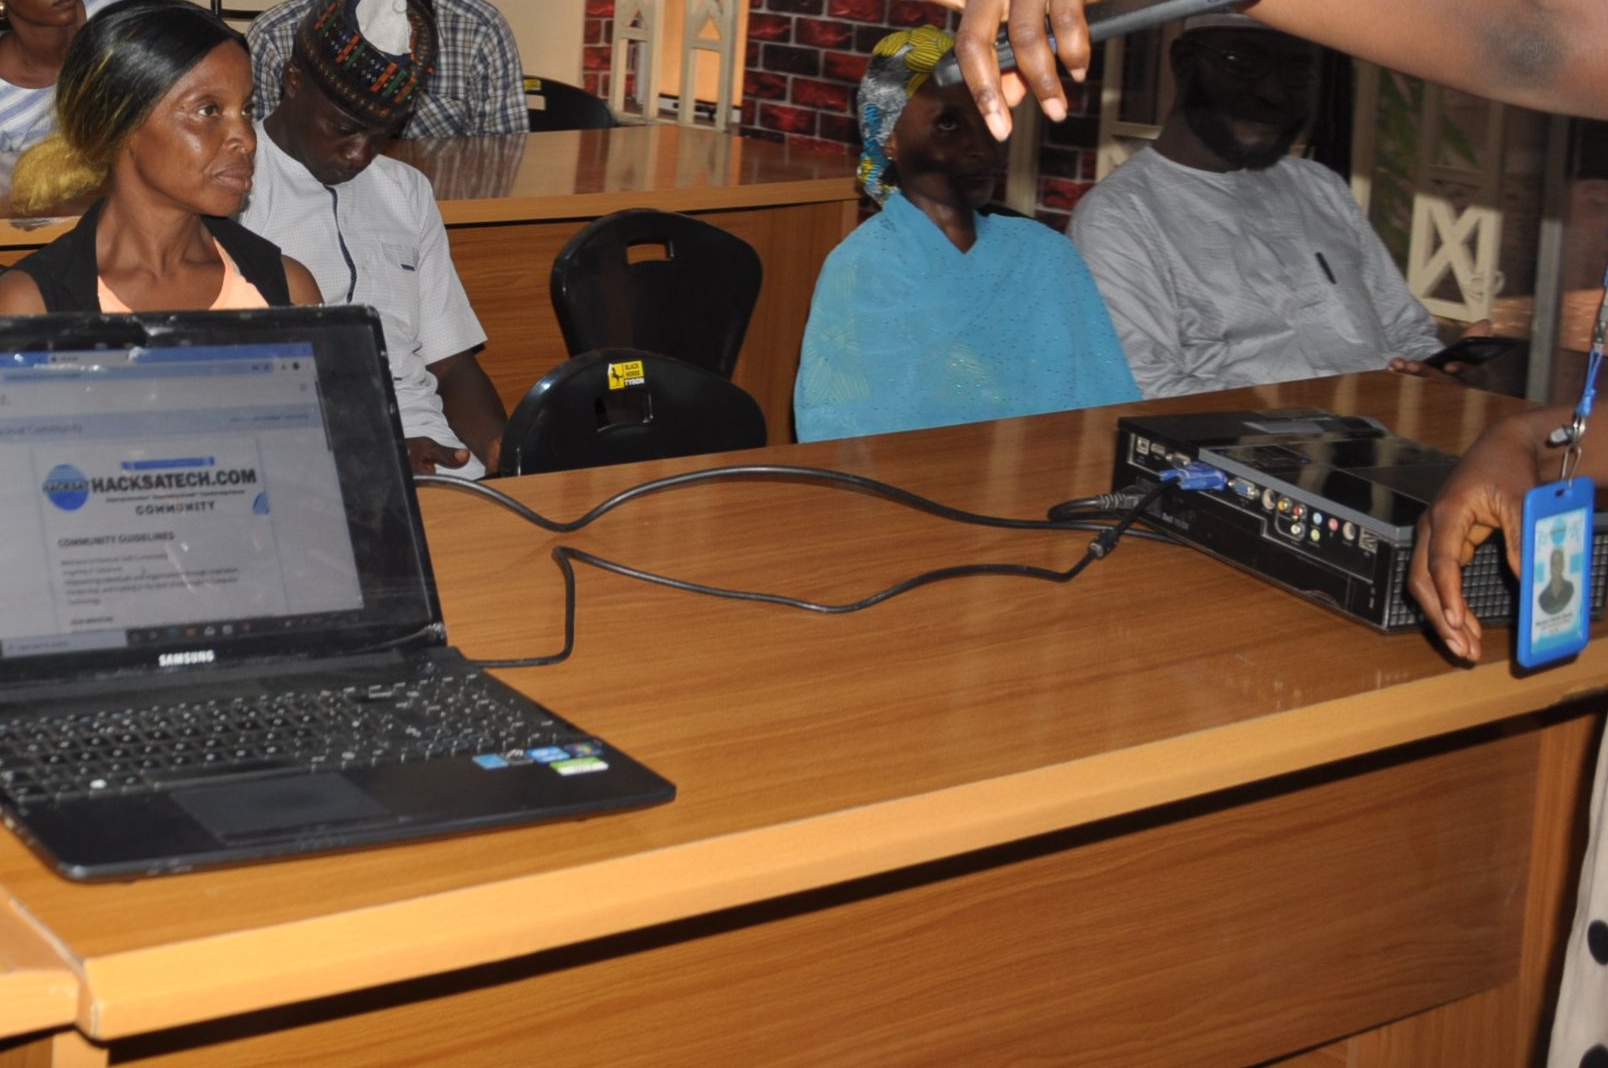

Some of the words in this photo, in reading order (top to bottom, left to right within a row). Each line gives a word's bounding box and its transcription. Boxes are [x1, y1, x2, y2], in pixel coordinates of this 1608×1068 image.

[92, 469, 257, 494] HACKSATECH.COM
[135, 501, 216, 516] COMMUNITY
[158, 649, 215, 667] SAMSUNG
